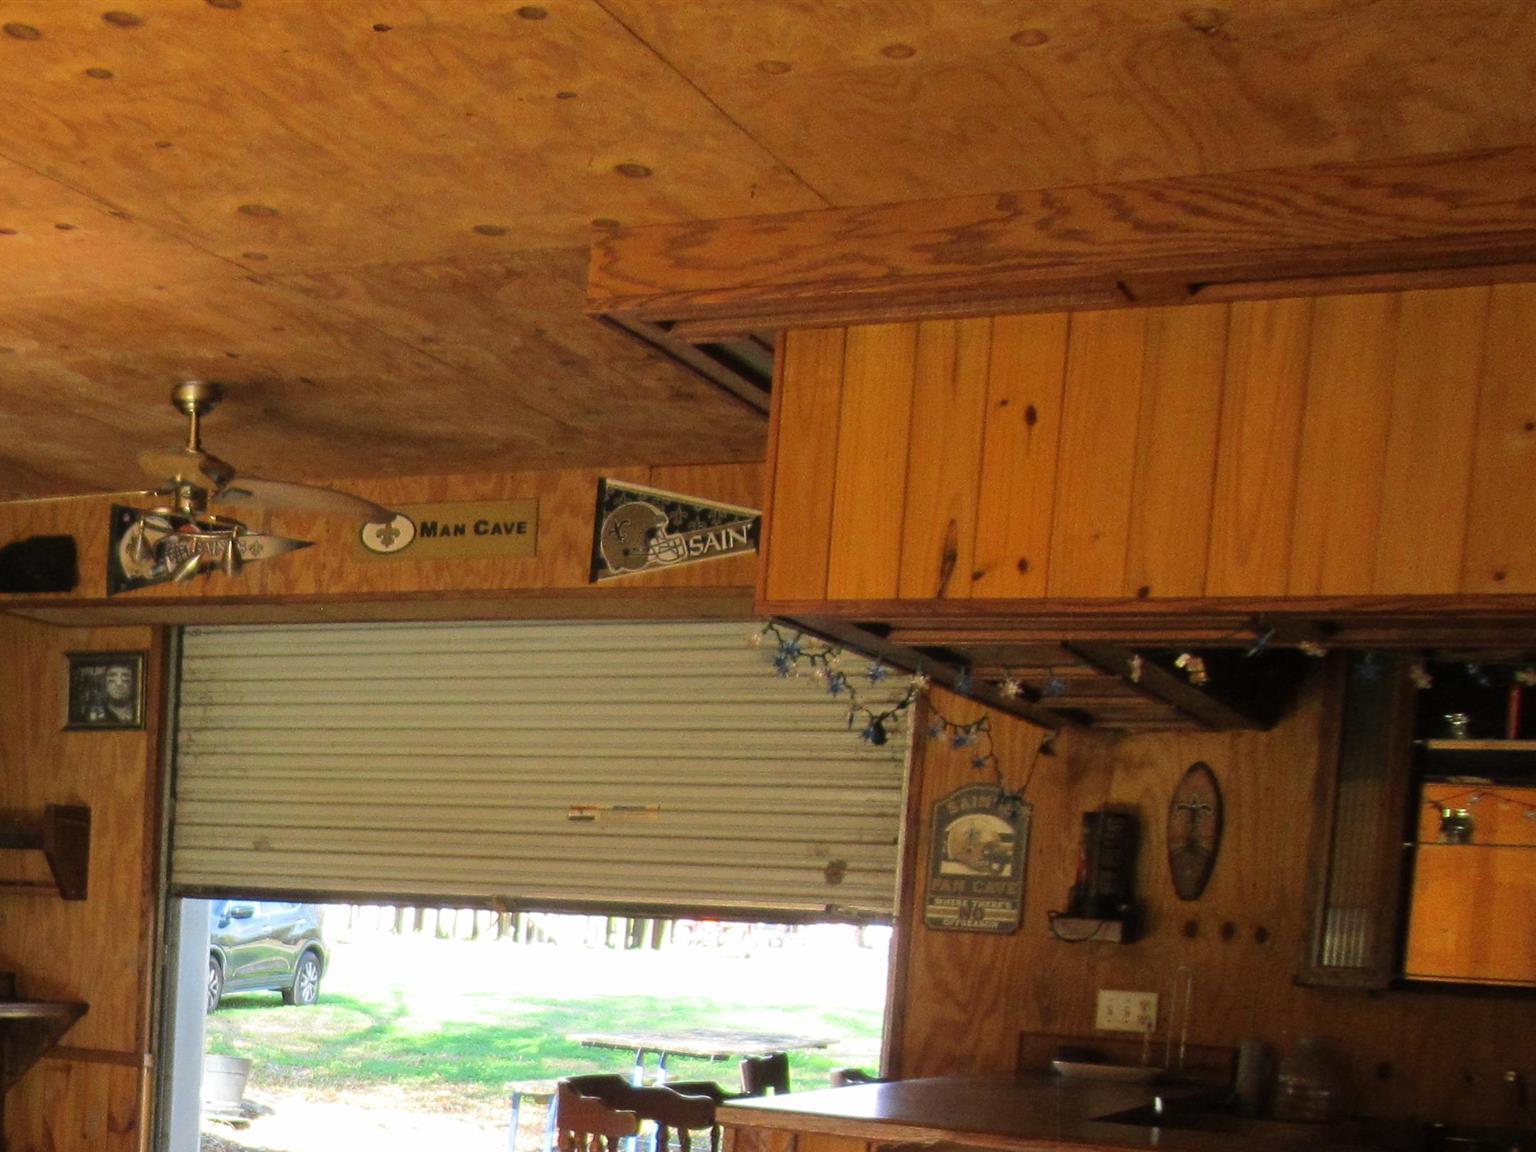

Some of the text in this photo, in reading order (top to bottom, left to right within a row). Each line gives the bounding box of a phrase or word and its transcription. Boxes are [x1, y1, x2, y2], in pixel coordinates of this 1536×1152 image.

[420, 509, 527, 538] MAN CAVE
[689, 523, 752, 557] SAIN
